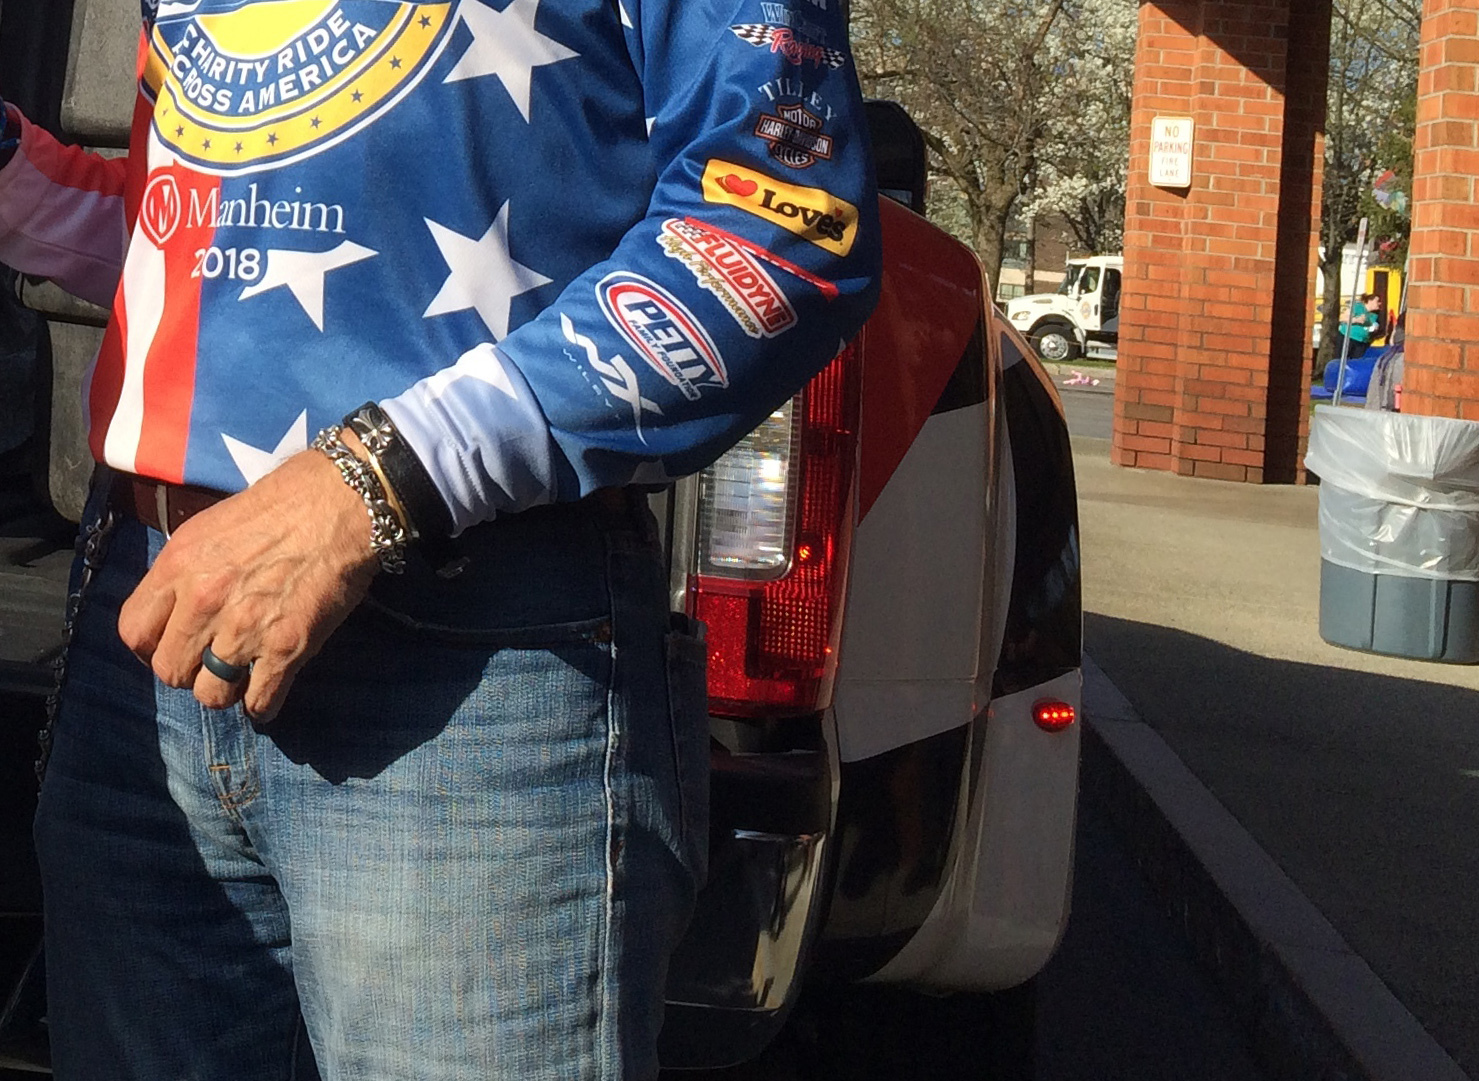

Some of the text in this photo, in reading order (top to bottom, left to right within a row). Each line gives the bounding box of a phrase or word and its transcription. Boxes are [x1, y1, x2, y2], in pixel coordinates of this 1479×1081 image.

[182, 8, 351, 85] CHARITY RIDE
[237, 22, 377, 114] AMERICA
[783, 109, 817, 130] MOTOR
[1164, 125, 1180, 138] NO
[1153, 141, 1189, 155] PARKING
[1161, 157, 1179, 166] FIRE
[1159, 168, 1180, 177] LANE
[185, 183, 346, 234] Manheim
[190, 246, 260, 281] 2018
[692, 233, 789, 328] FLUIDYNE
[628, 319, 660, 349] FAMILY
